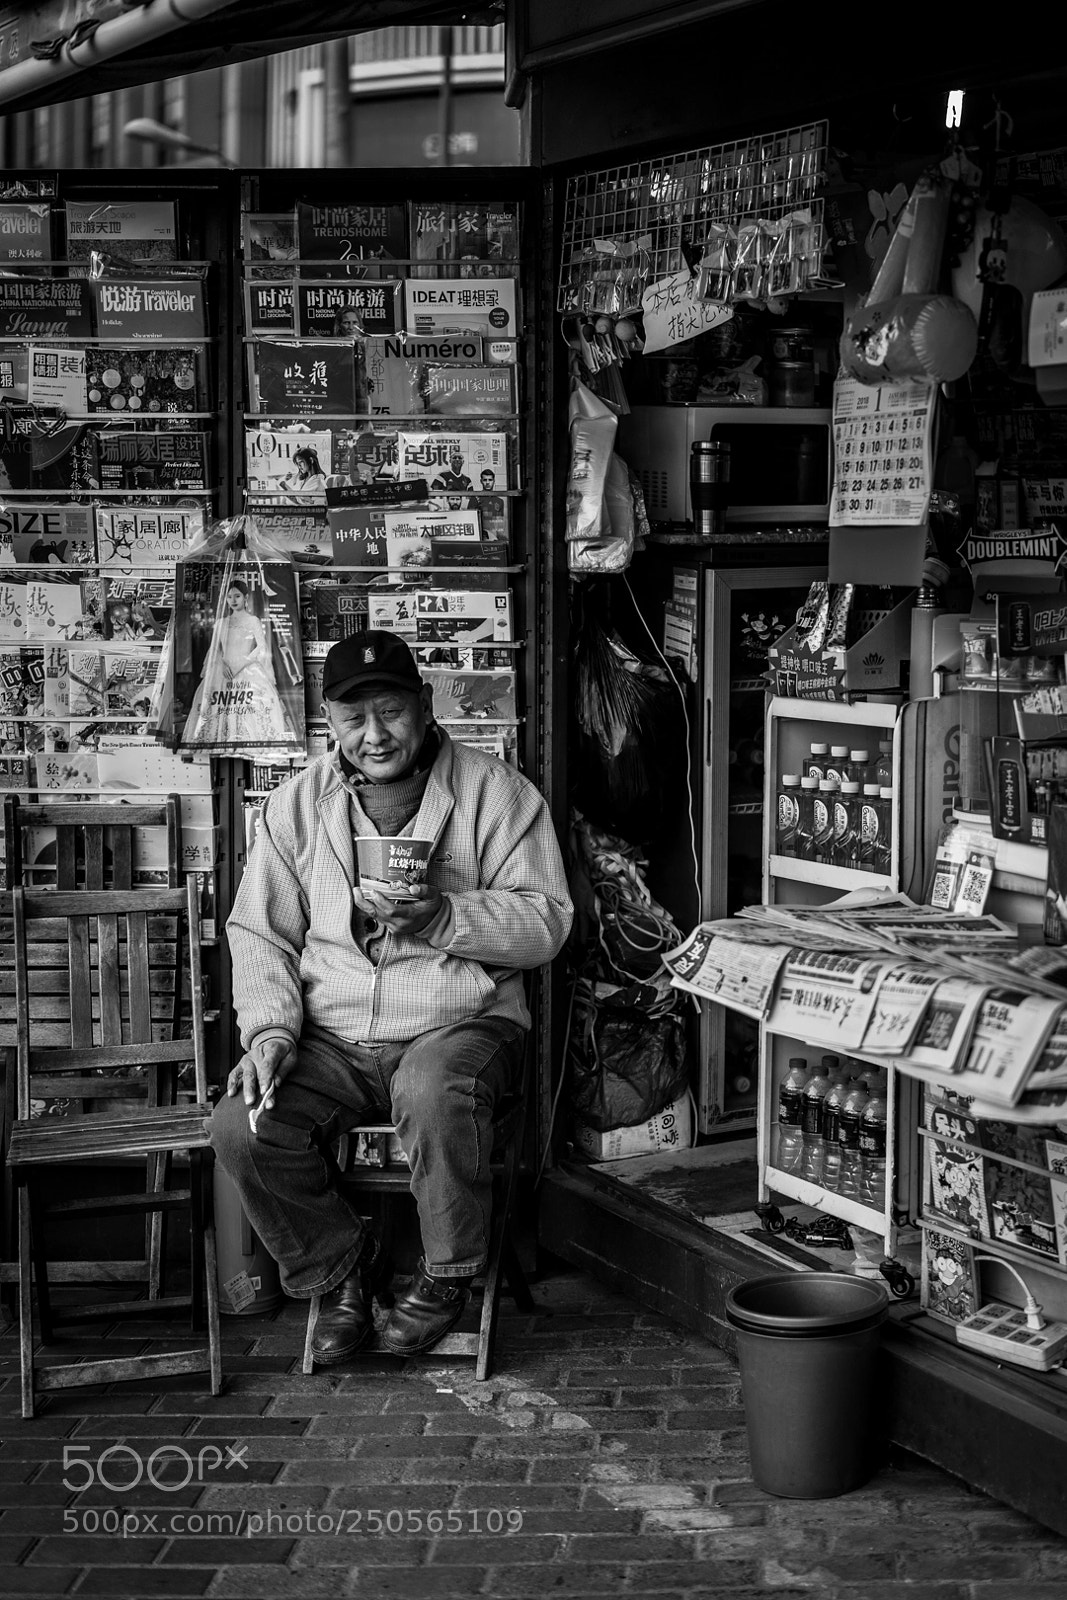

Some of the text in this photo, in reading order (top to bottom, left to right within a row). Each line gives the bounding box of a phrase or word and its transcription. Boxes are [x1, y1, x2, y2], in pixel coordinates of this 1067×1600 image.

[312, 207, 386, 227] 时尚家居
[416, 211, 479, 233] 旅行家
[70, 221, 121, 234] 旅游天地
[313, 227, 387, 237] TRENDSHOME
[100, 286, 141, 312] 悦游
[140, 289, 196, 312] Traveler
[257, 288, 293, 307] 时尚
[306, 288, 386, 307] 时尚旅游
[413, 289, 499, 307] IDEAT 理想家
[358, 308, 386, 319] VELER
[5, 312, 69, 334] Sanya
[384, 339, 477, 359] Numéro
[874, 387, 882, 412] 1
[862, 422, 867, 435] 2
[875, 421, 881, 433] 3
[888, 420, 894, 432] 4
[902, 418, 908, 430] 5
[916, 417, 921, 429] 6
[100, 436, 175, 462] 瑞丽家居
[175, 436, 201, 451] 设计
[845, 437, 921, 454] 8 9 10 11 12 13
[842, 456, 920, 473] 15 16 17 18 19 20
[852, 480, 862, 492] 23
[866, 479, 876, 492] 24
[880, 478, 889, 490] 25
[893, 477, 902, 490] 26
[908, 477, 920, 489] 27
[849, 498, 860, 511] 30
[865, 498, 873, 511] 31
[117, 519, 181, 534] 家居廊
[251, 515, 306, 527] TopGear
[336, 526, 387, 543] 中华人民
[993, 530, 1028, 538] WRIGLEY'S
[366, 542, 380, 555] 地
[967, 536, 1059, 561] DOUBLEMINT
[211, 690, 254, 706] SNH48
[1005, 769, 1015, 817] 王老吉
